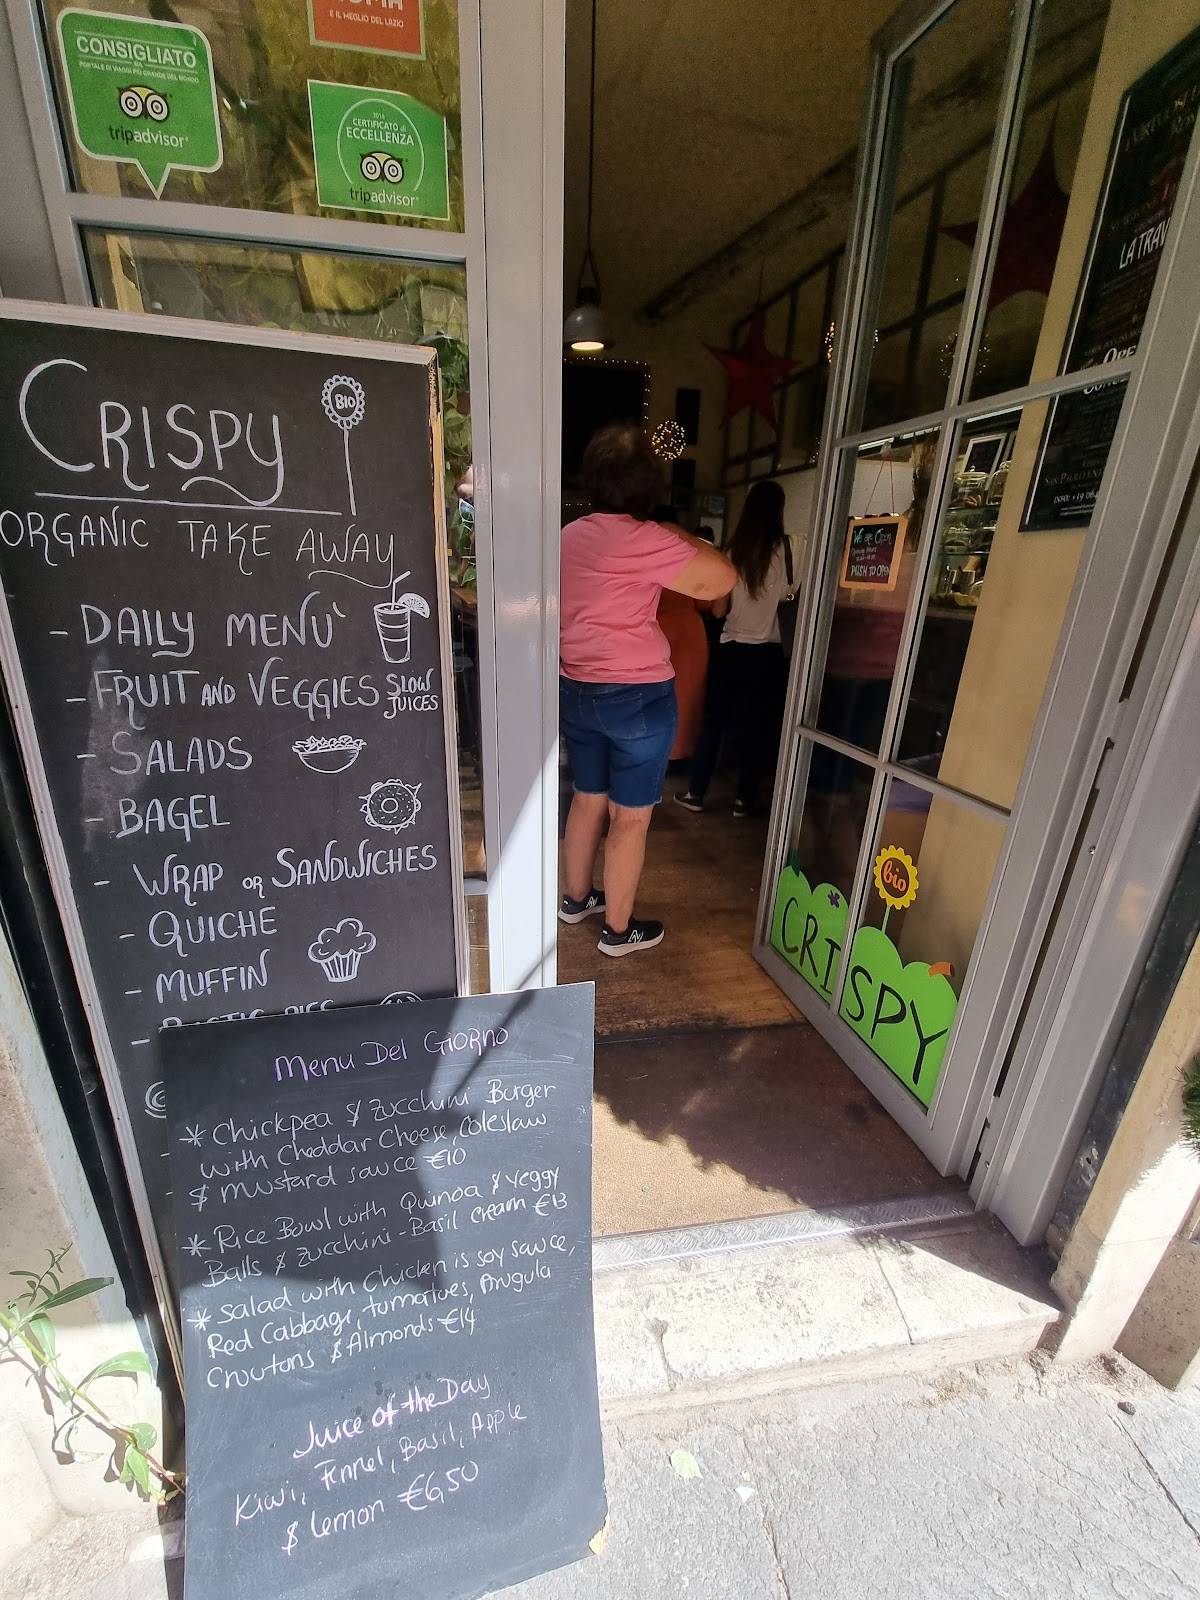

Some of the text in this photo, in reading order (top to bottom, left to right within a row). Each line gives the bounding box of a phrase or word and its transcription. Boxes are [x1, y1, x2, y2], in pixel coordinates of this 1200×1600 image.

[335, 11, 341, 19] IL
[343, 12, 369, 22] MEGLIO
[370, 16, 384, 25] DEL
[385, 17, 404, 28] LAZIO
[76, 35, 197, 69] CONSIGLIATO
[108, 125, 189, 149] tripadvisor
[346, 126, 415, 147] ECCELLENZA
[352, 118, 399, 131] CERTIFICATO
[349, 187, 416, 207] tripadvisor
[1118, 237, 1138, 270] LA
[19, 358, 357, 507] CRISPY BIO
[0, 505, 395, 589] ORGANIC TAKE AWAY
[850, 564, 868, 577] PUSH
[868, 566, 877, 577] TO
[81, 603, 195, 658] DAILY
[93, 657, 381, 727] FRUIT AND VEGGIES
[385, 667, 434, 697] SLOW
[382, 695, 440, 720] JUICES
[109, 730, 253, 777] SALADS
[114, 794, 230, 842] BAGEL
[132, 838, 438, 906] WRAP OR SANDWICHES
[882, 860, 907, 892] bio
[148, 906, 278, 957] QUICHE
[155, 948, 270, 1003] MUFFIN
[274, 1053, 355, 1082] Menu
[360, 1038, 408, 1066] Del
[212, 1111, 334, 1146] Chickpea
[485, 1078, 556, 1108] Burger
[200, 1149, 269, 1179] with
[459, 1108, 547, 1138] Coleslaw
[348, 1155, 419, 1184] sauce
[423, 1147, 467, 1170] €10
[202, 1254, 263, 1288] Balls
[408, 1209, 459, 1237] Basil
[531, 1191, 569, 1217] €13
[213, 1224, 271, 1254] Rice
[274, 1206, 332, 1240] Bowl
[338, 1200, 387, 1227] with
[400, 1184, 484, 1215] Quinoa
[301, 1275, 356, 1304] with
[362, 1258, 448, 1293] Chicken
[454, 1251, 470, 1269] is
[476, 1246, 505, 1268] soy
[206, 1328, 255, 1359] Red
[479, 1258, 552, 1296] Arugula
[206, 1349, 315, 1390] Croutons
[346, 1313, 434, 1359] Almonds
[437, 1306, 477, 1337] €14
[292, 1373, 491, 1460] Juice of the Day
